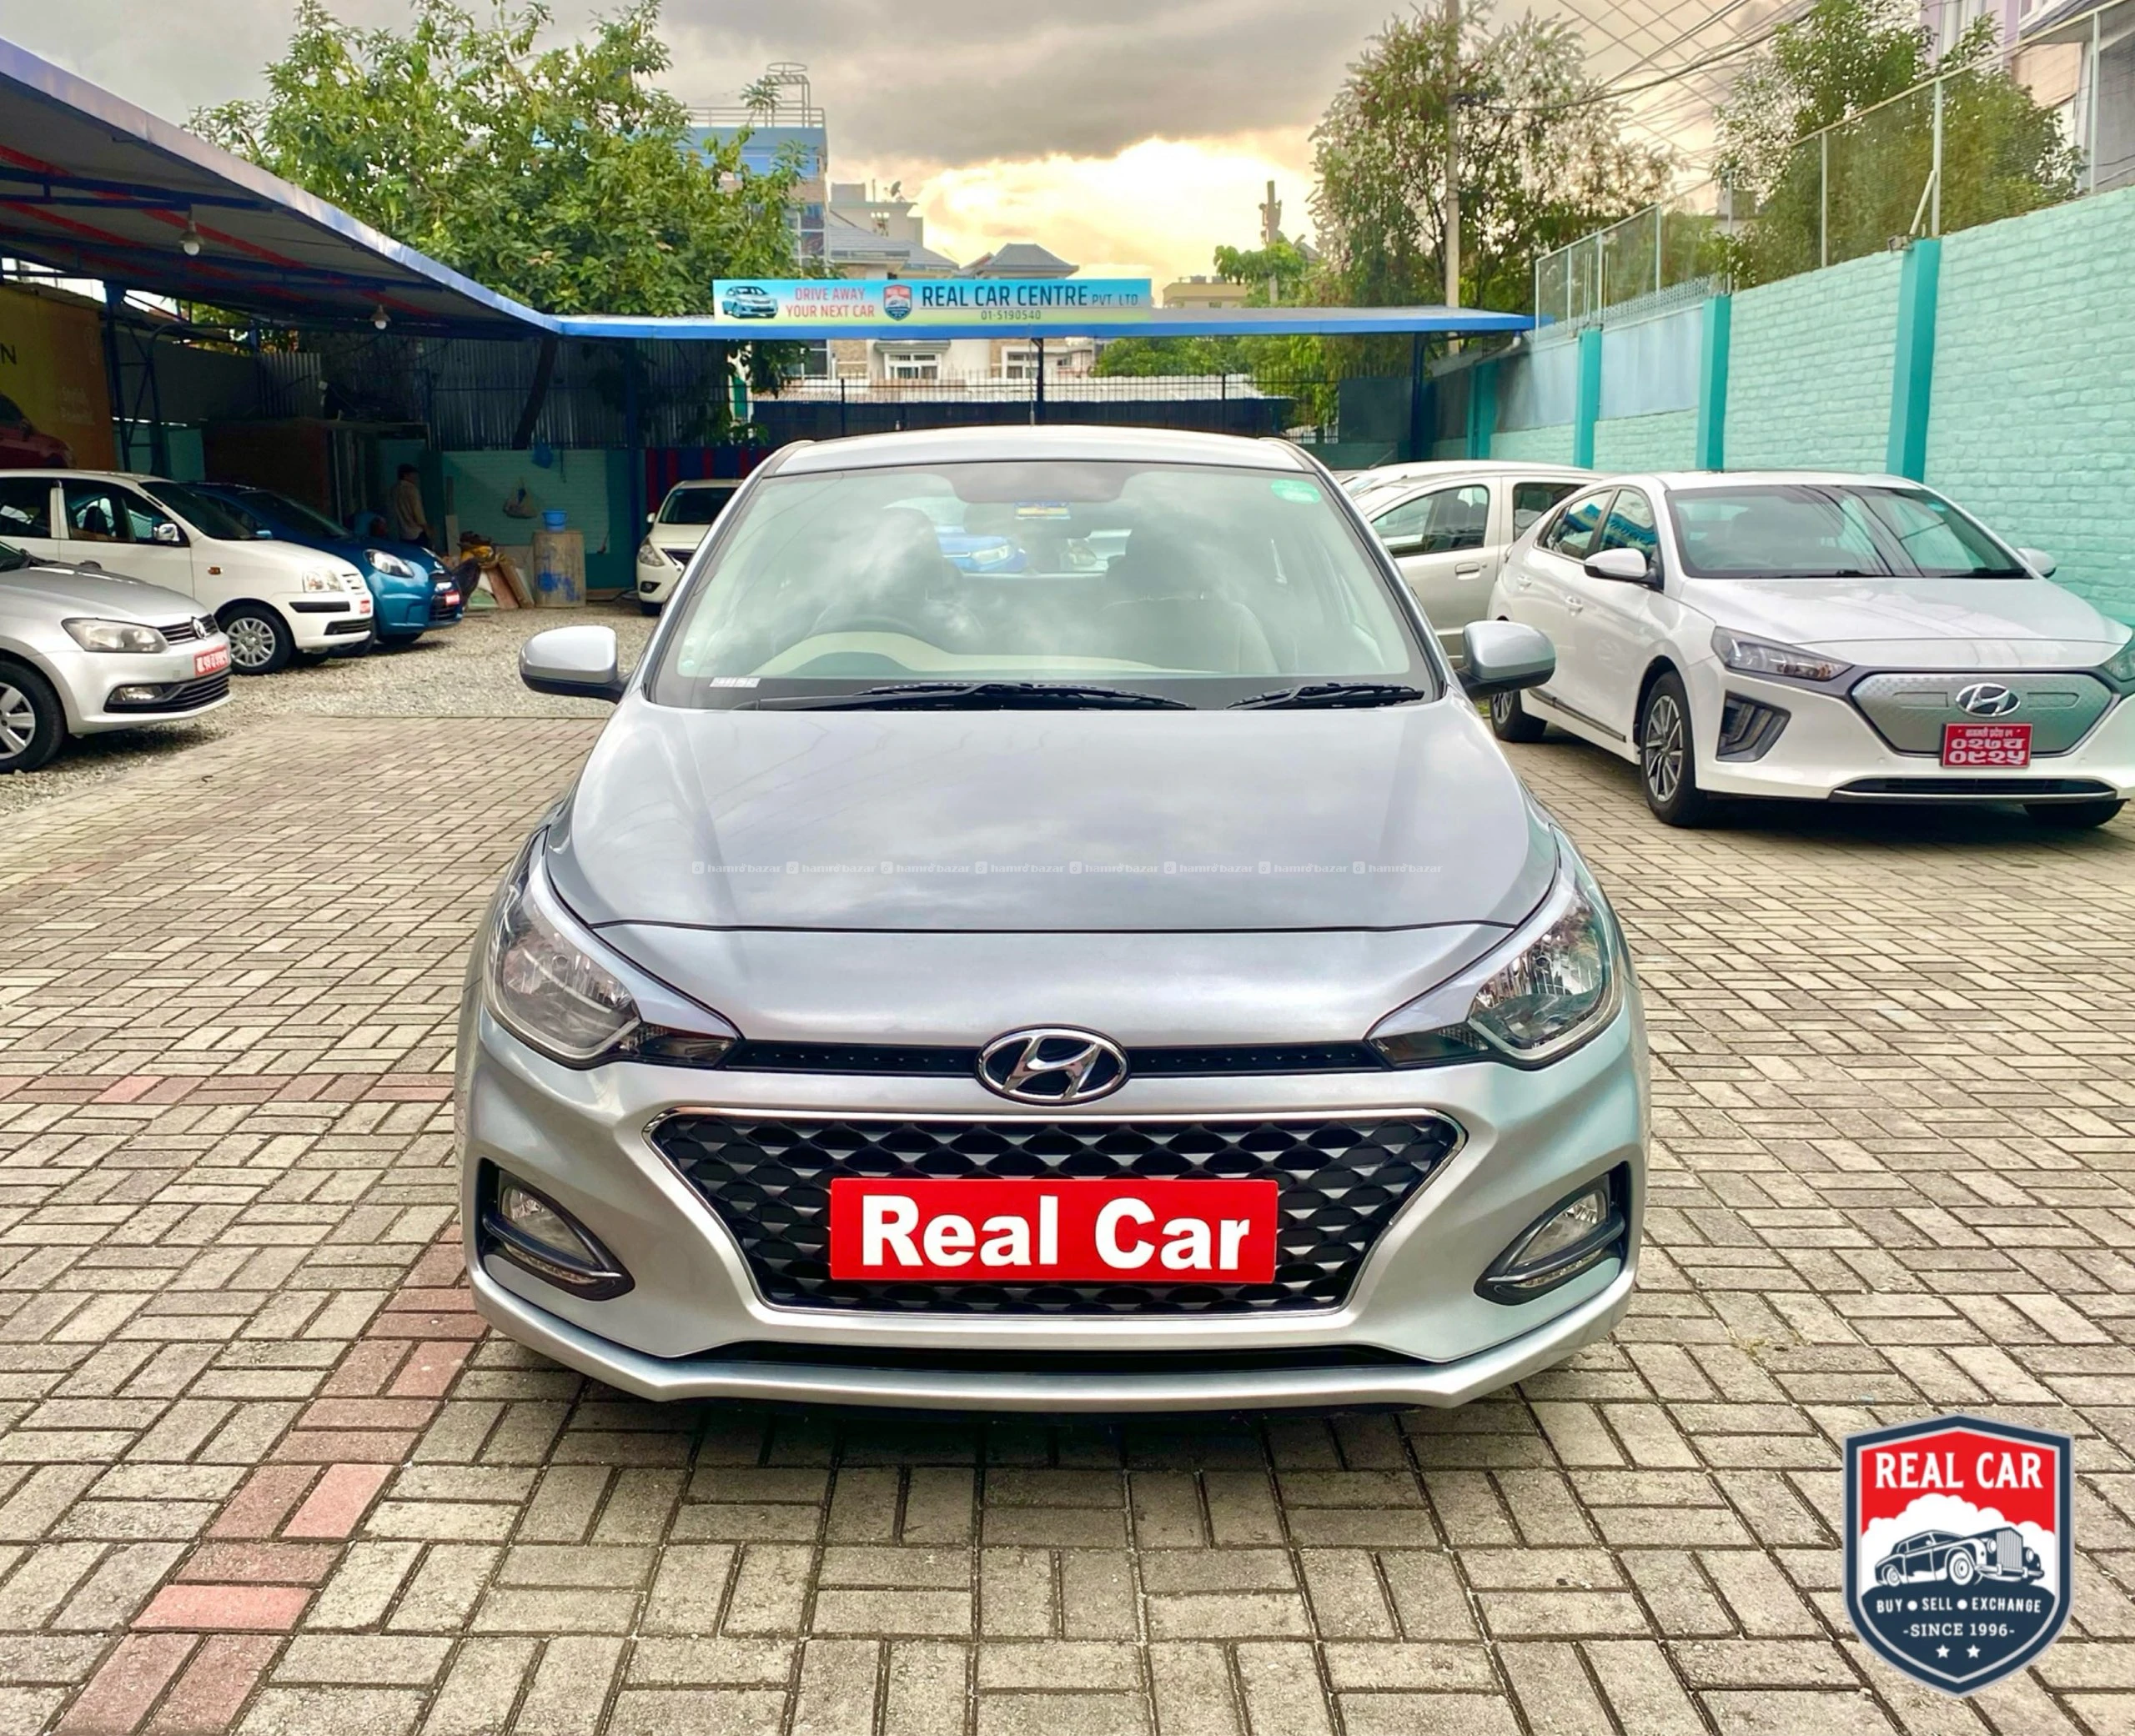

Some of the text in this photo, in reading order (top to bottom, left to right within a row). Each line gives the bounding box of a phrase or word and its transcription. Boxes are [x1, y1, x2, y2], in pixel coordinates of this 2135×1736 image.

[795, 287, 866, 301] DRIVE AWAY
[922, 285, 969, 307] REAL
[974, 285, 1011, 307] CAR
[1017, 285, 1088, 307] CENTRE
[786, 304, 817, 318] YOUR
[821, 304, 849, 318] NEXT
[852, 304, 875, 318] CAR
[981, 310, 1042, 321] 01-5190540
[862, 1195, 1249, 1270] Real Car
